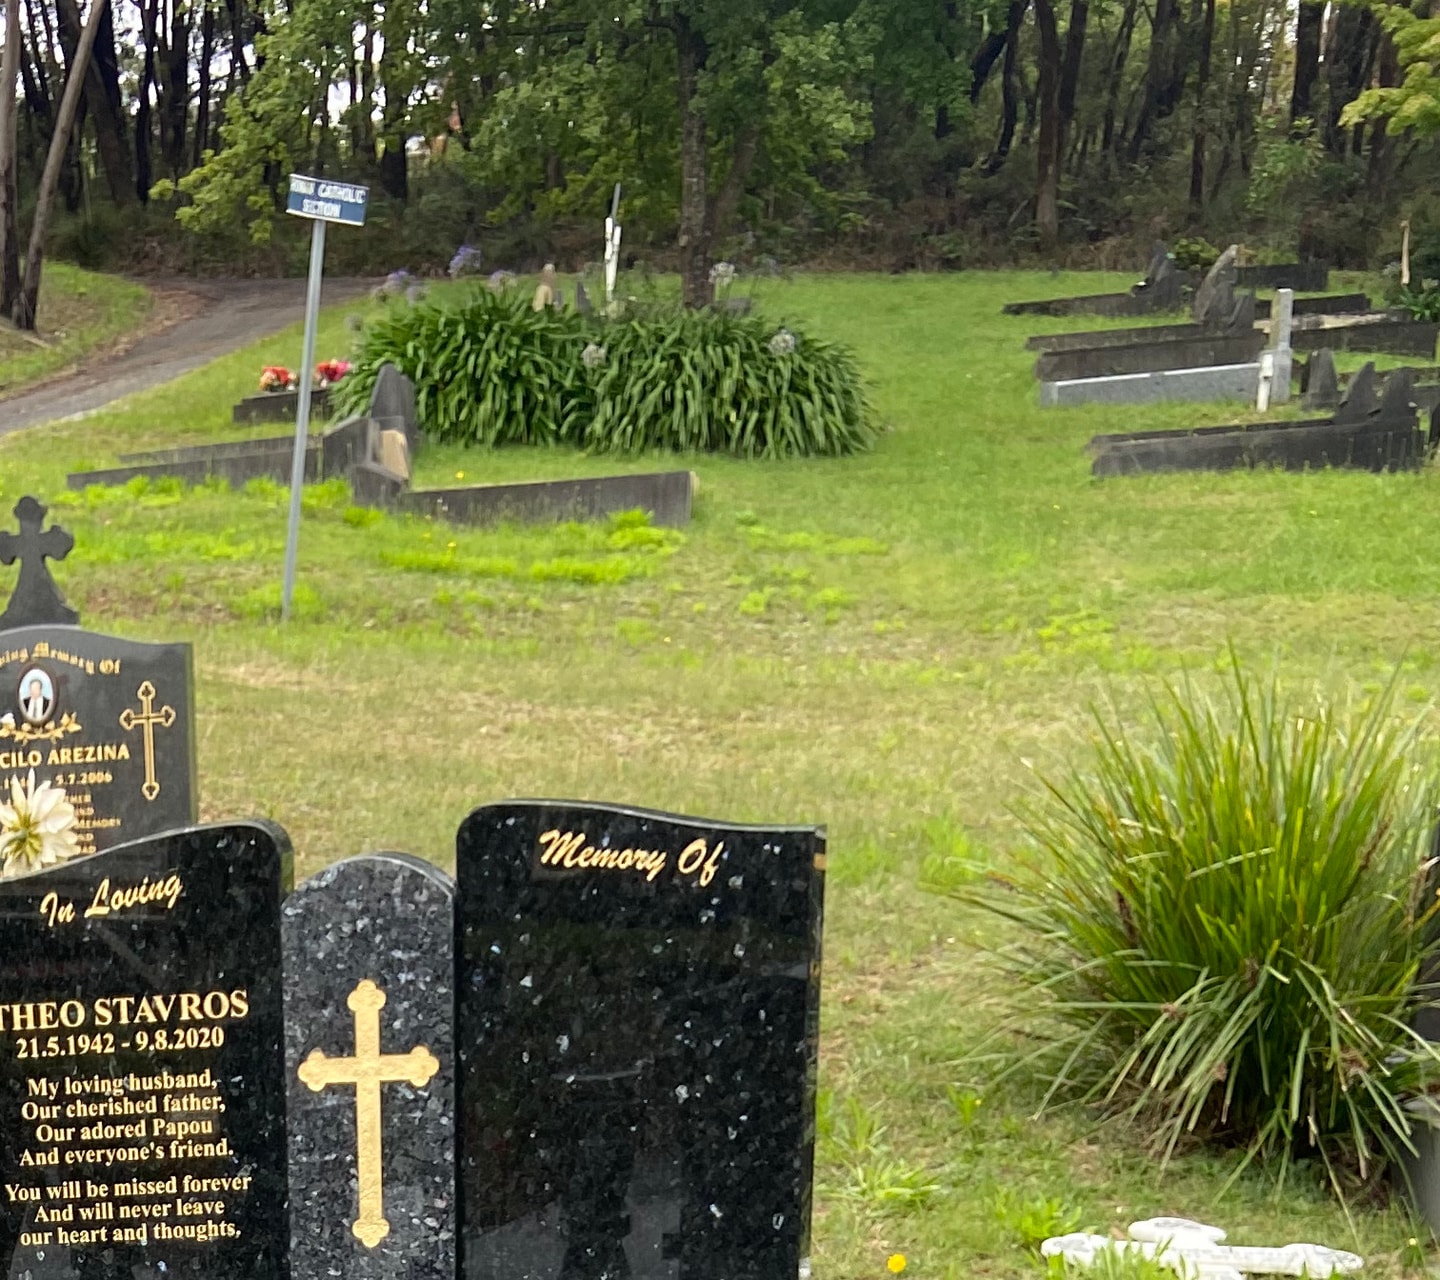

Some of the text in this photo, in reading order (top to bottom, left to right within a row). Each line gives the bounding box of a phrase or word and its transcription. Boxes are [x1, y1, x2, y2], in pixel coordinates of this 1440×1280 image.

[318, 184, 366, 204] CATHOLIC
[47, 743, 130, 766] AREZINA
[539, 829, 725, 888] Memory Of
[40, 872, 184, 928] In Loving
[94, 989, 250, 1028] STAVROS
[17, 1033, 115, 1058] 21.5.1942
[136, 1027, 224, 1051] 9.8.2020
[28, 1069, 216, 1100] My loving husband,
[22, 1094, 226, 1120] Our cherished father,
[36, 1120, 212, 1142] Our adored Papou
[22, 1138, 234, 1165] And everyone's friend.
[6, 1175, 249, 1201] You will be missed forever
[37, 1200, 224, 1222] And will never leave
[20, 1233, 49, 1245] our
[58, 1228, 106, 1243] heart
[113, 1227, 147, 1241] and
